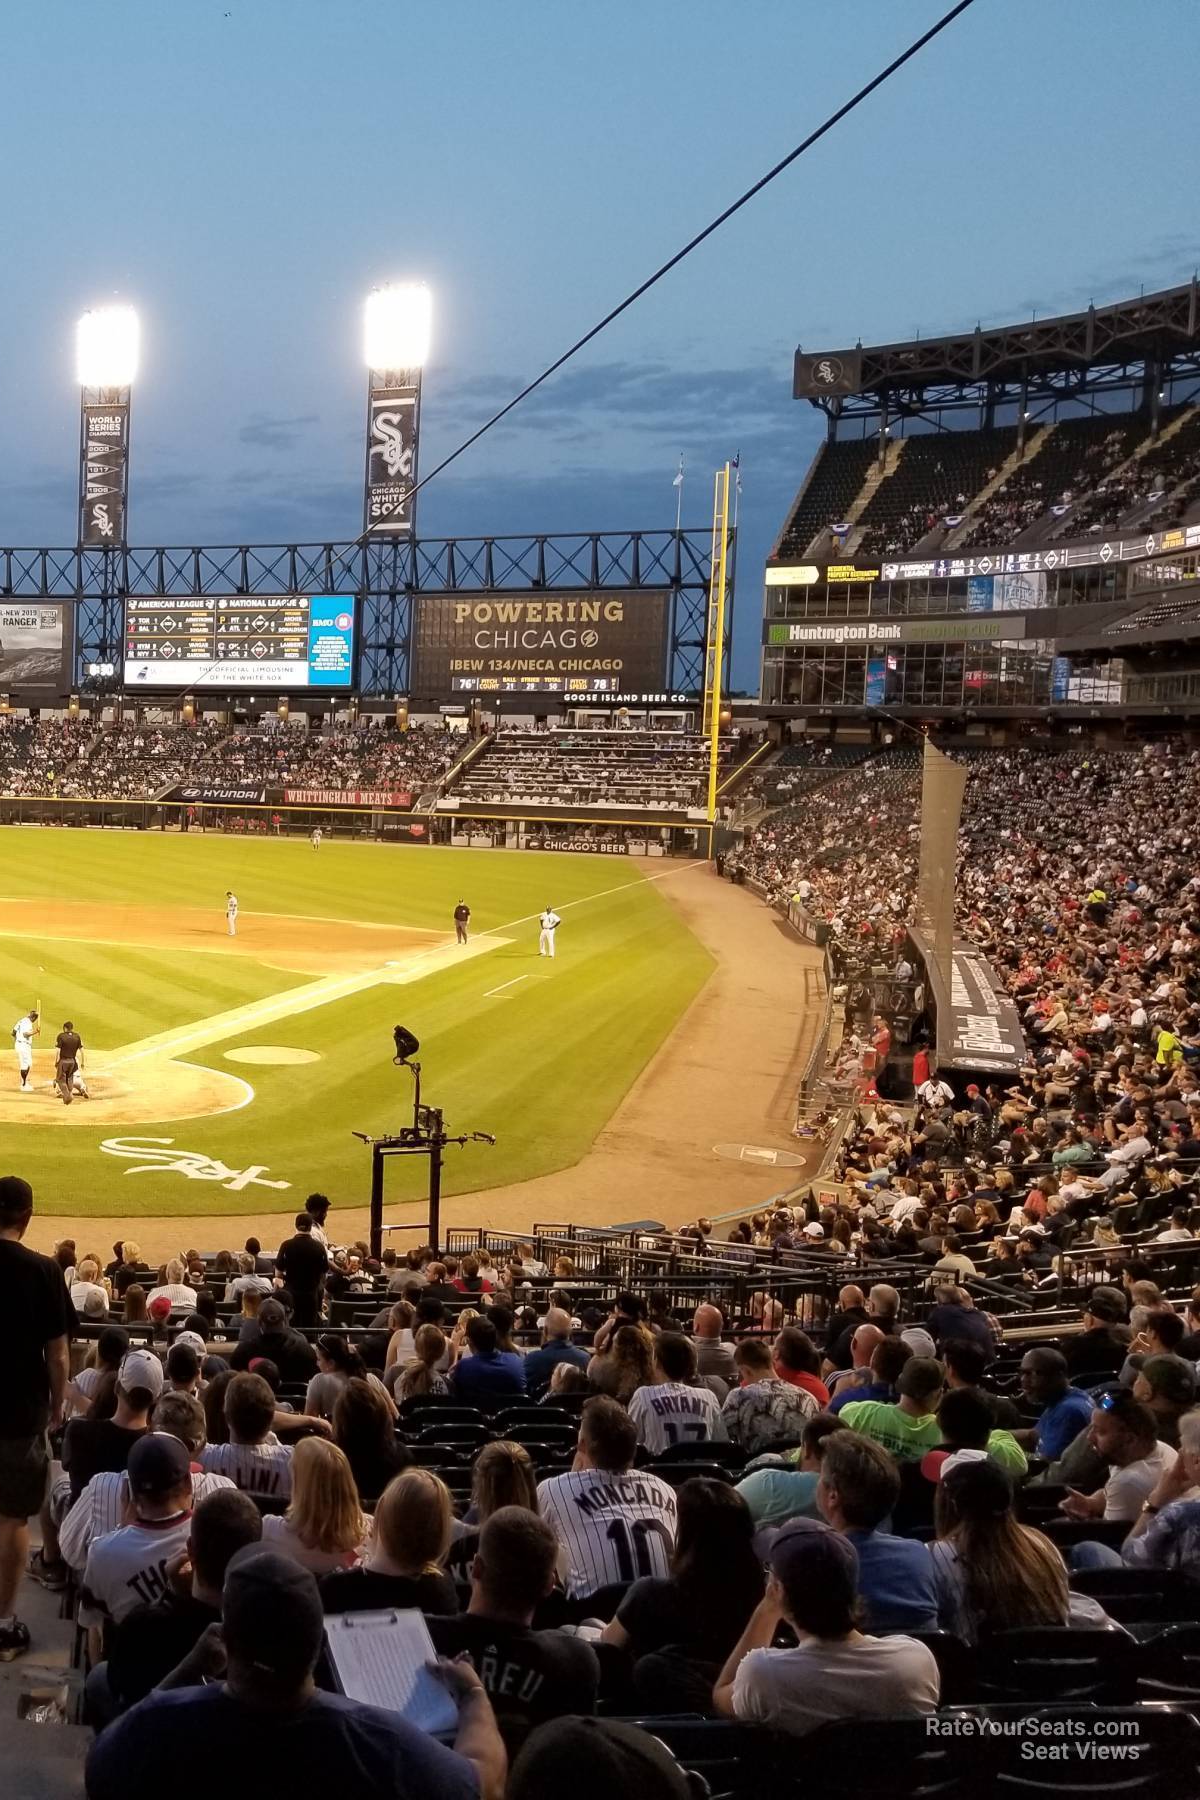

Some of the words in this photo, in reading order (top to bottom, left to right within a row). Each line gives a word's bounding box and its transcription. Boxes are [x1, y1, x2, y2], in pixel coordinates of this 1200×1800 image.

[372, 494, 405, 503] WHITE
[372, 503, 404, 515] SOX
[138, 600, 174, 608] AMERICAN
[177, 600, 204, 608] LEAGUE
[230, 599, 266, 607] NATIONAL
[455, 601, 624, 624] POWERING
[3, 618, 37, 626] RANGER
[790, 624, 866, 643] Huntington
[868, 624, 900, 639] Bank
[450, 658, 485, 671] IBEW
[488, 658, 555, 671] 134/NECA
[559, 658, 623, 671] CHICAGO
[594, 679, 606, 689] 78
[602, 694, 637, 702] ISLAND
[642, 694, 667, 702] BEER
[203, 789, 258, 799] HYUNDAI
[288, 790, 355, 804] WHITTINGHAM
[360, 792, 393, 805] MEATS
[543, 840, 598, 852] CHICAGO'S
[601, 843, 625, 853] BEER
[652, 1396, 710, 1417] BRYANT
[663, 1421, 706, 1443] 17
[574, 1482, 676, 1518] MONCADA
[607, 1518, 674, 1581] 10
